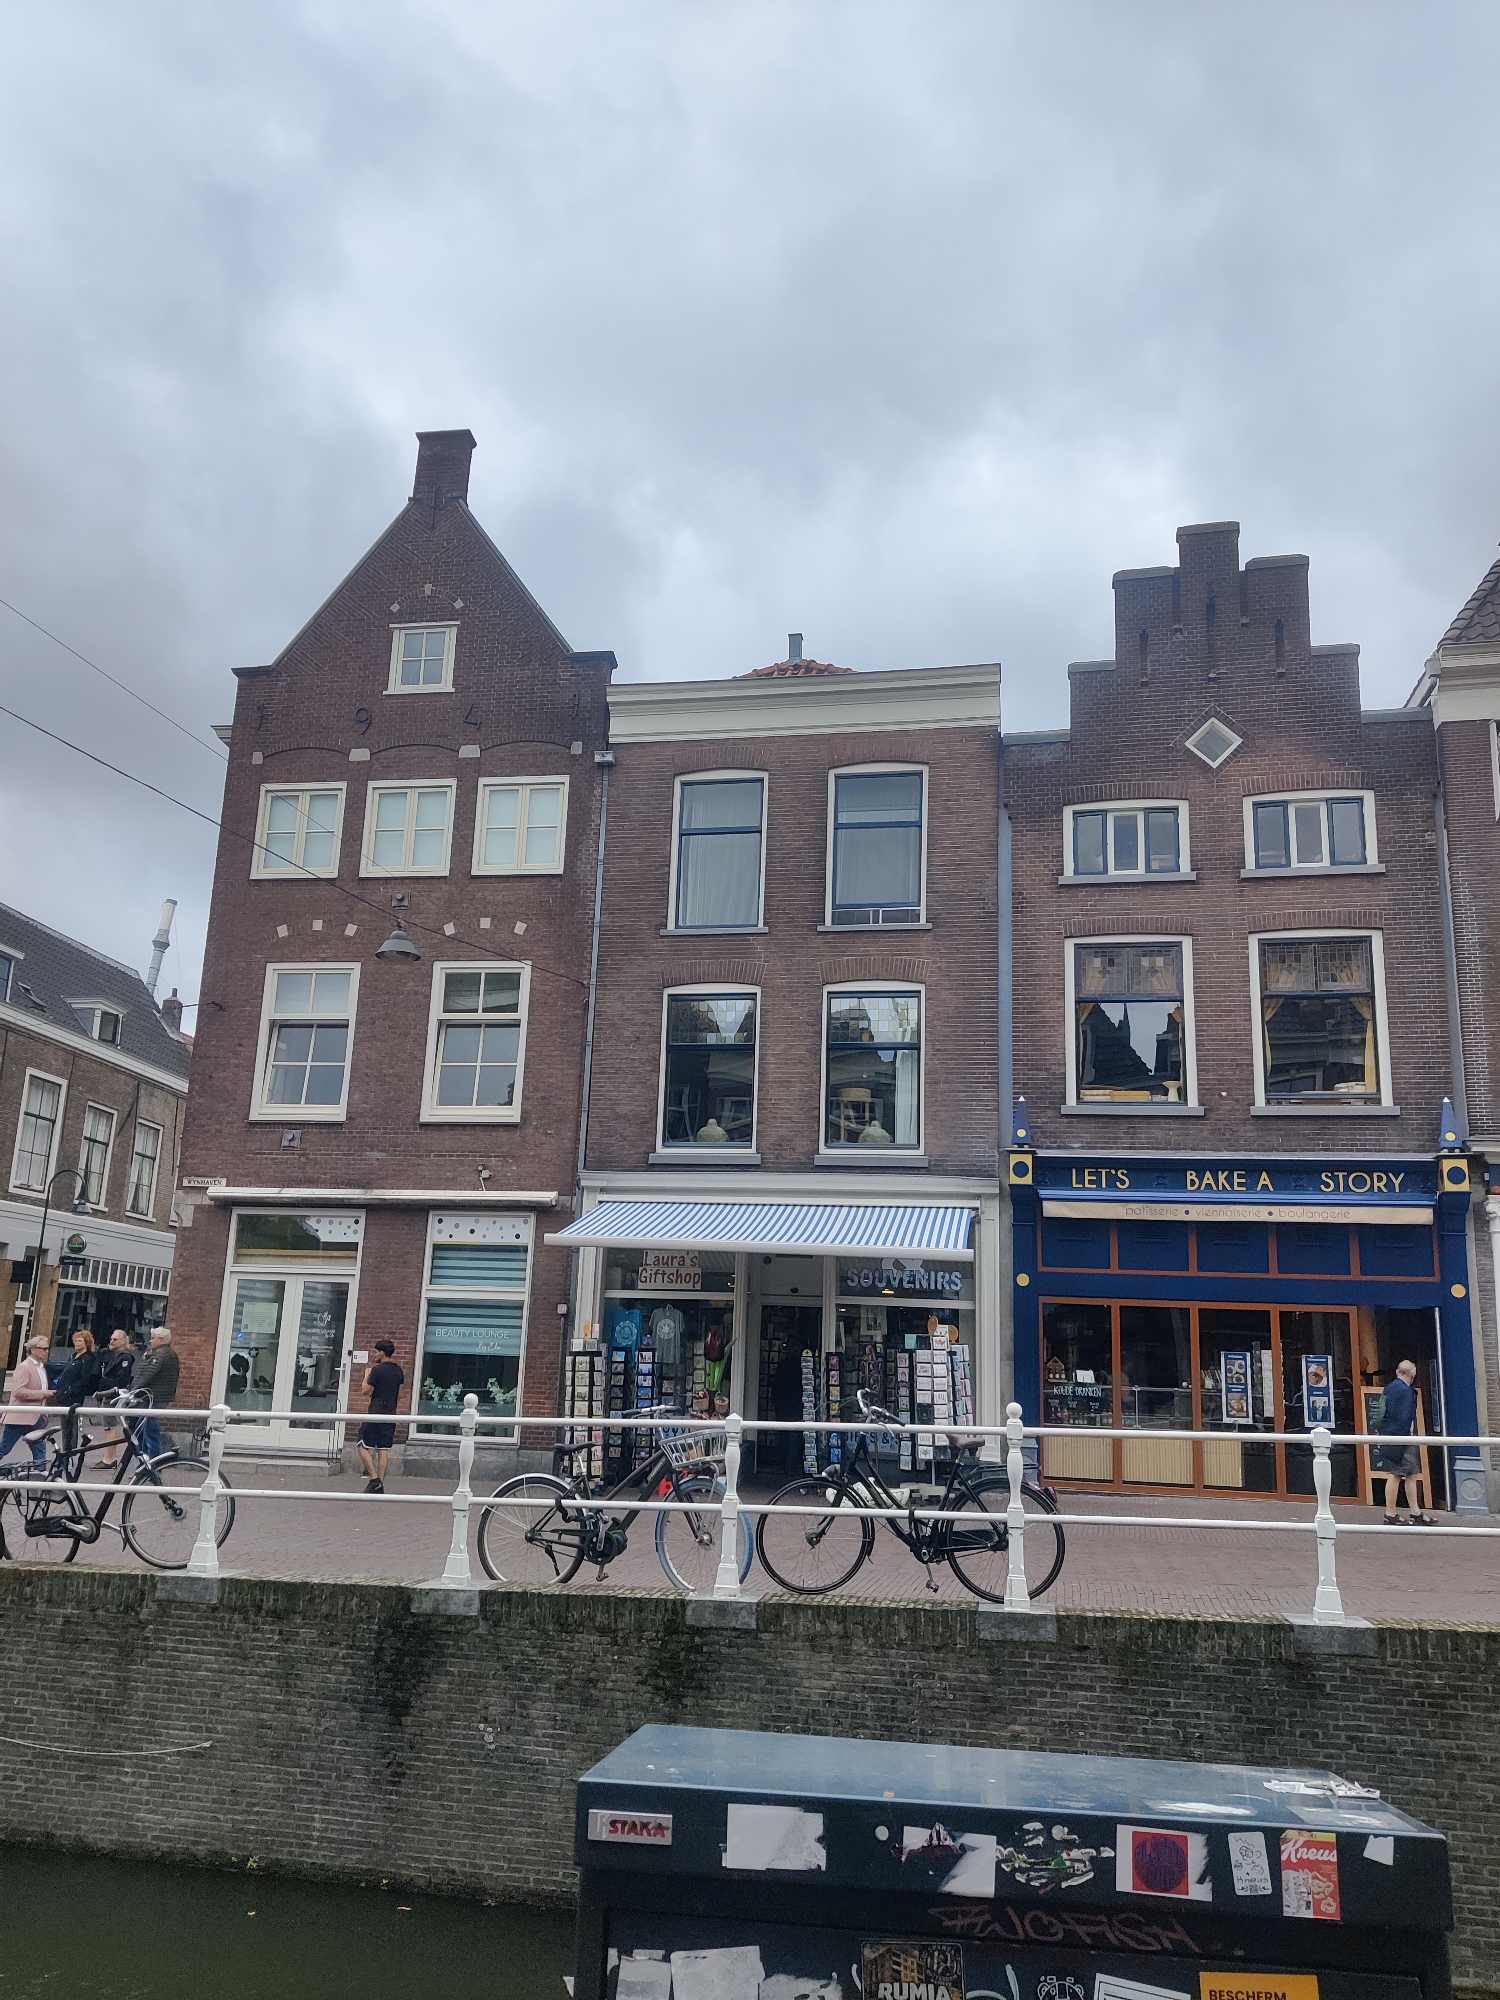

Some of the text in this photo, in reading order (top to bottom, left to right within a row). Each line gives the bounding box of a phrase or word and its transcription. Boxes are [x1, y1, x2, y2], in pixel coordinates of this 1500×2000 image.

[1071, 1168, 1405, 1193] LET'S BAKE A STORY
[1125, 1206, 1351, 1221] patisserie viennoiserie boulangerie
[643, 1250, 698, 1267] Laura's
[639, 1267, 701, 1289] Giftshop
[846, 1268, 963, 1291] SOUVENIRS
[435, 1328, 510, 1339] BEAUTY LOUNGE
[608, 1819, 669, 1838] STAKA
[878, 1981, 952, 2000] RUMIA
